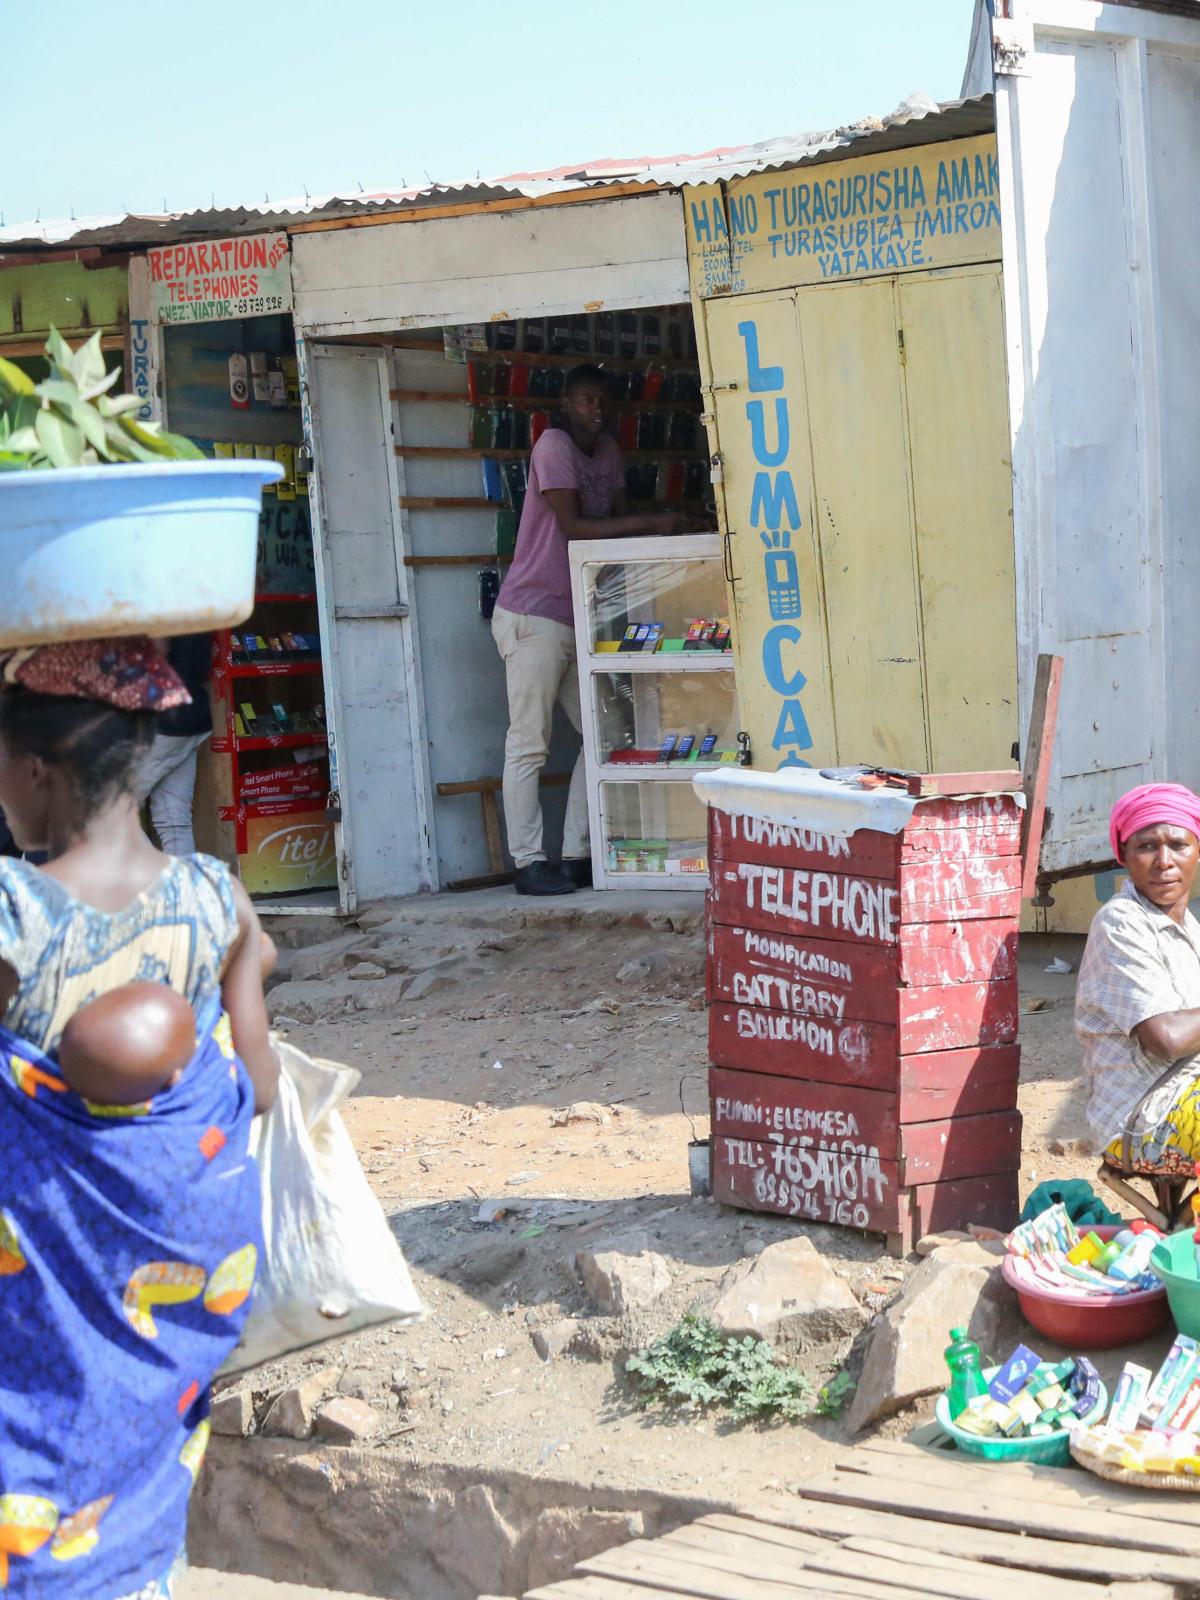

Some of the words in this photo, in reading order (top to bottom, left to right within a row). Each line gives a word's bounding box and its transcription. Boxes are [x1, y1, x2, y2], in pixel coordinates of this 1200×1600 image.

[691, 193, 757, 242] HANO
[764, 164, 925, 229] TURAGURISHA
[768, 214, 903, 258] TURASUBIZA
[150, 238, 267, 282] REPARATION
[268, 237, 288, 269] DES
[167, 274, 258, 303] TELEPHONES
[190, 300, 233, 320] VIATOR
[279, 831, 328, 863] itel
[745, 931, 852, 982] MODIFICATION
[733, 972, 846, 1027] BATTERRY
